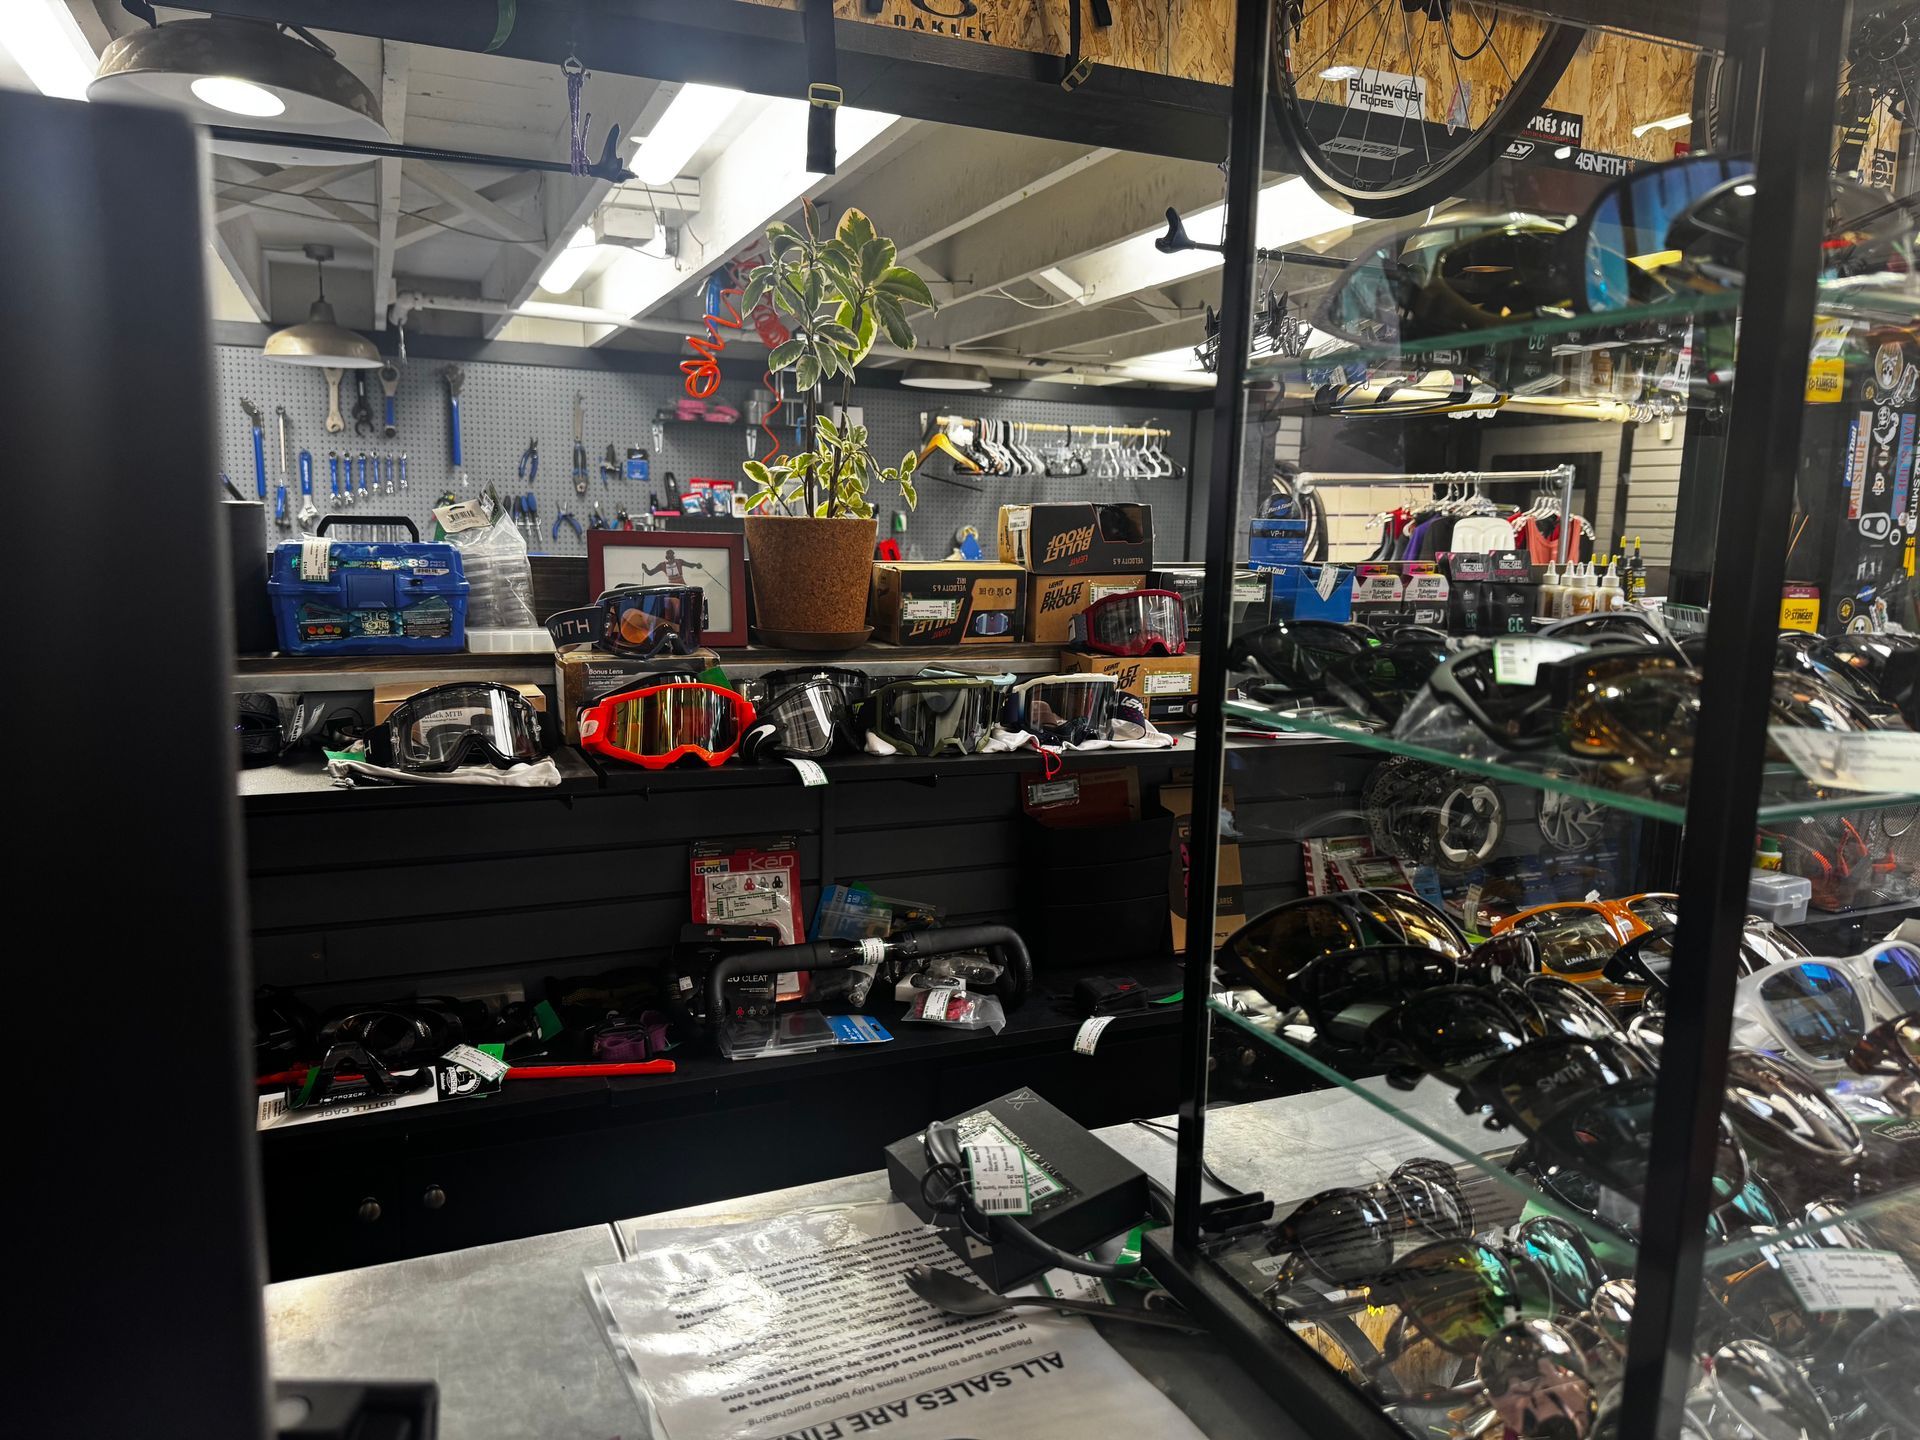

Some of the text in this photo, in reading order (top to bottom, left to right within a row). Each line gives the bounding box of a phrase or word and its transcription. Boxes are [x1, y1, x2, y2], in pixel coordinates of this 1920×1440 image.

[894, 14, 992, 41] OAKLEY
[1349, 78, 1423, 101] BlueWater
[1360, 94, 1394, 109] Ropes
[1527, 113, 1557, 133] PRÉS
[1560, 120, 1580, 139] SKI
[1575, 151, 1627, 177] 45NRTH
[1048, 524, 1096, 548] PROOF
[1043, 539, 1093, 564] BULLET
[942, 584, 967, 592] VELOCITY
[1043, 582, 1085, 601] BULLET
[1039, 592, 1083, 614] PROOF
[360, 610, 389, 622] BIG
[550, 618, 590, 639] MITH
[445, 710, 463, 718] MTB
[695, 865, 720, 874] LOOK
[1564, 957, 1585, 966] LUMA
[741, 974, 769, 983] CLEAT
[1536, 1061, 1587, 1092] SMITH
[317, 1100, 397, 1119] BOTTLE CAGE
[859, 1244, 891, 1255] small
[898, 1242, 936, 1253] selling
[869, 1251, 901, 1261] these
[915, 1249, 946, 1260] allow
[885, 1256, 917, 1267] these
[776, 1285, 800, 1295] and
[886, 1288, 912, 1298] and
[673, 1311, 695, 1320] We
[907, 1304, 930, 1315] can
[904, 1317, 927, 1327] the
[996, 1313, 1020, 1324] will
[915, 1323, 946, 1336] after
[957, 1319, 999, 1335] accept
[1000, 1325, 1017, 1333] an
[1014, 1322, 1028, 1330] If
[861, 1331, 917, 1351] purchase
[916, 1331, 961, 1347] returns
[974, 1330, 1003, 1342] item
[900, 1343, 918, 1351] on
[929, 1341, 965, 1355] found
[898, 1355, 917, 1365] be
[916, 1351, 930, 1359] to
[843, 1360, 901, 1381] defective
[742, 1336, 1035, 1428] Please be sure to inspect items fully before purchasing.
[778, 1372, 815, 1387] basis
[812, 1376, 844, 1390] after
[746, 1387, 761, 1396] to
[760, 1381, 779, 1392] up
[844, 1352, 1071, 1433] ALL SALES ARE
[719, 1391, 746, 1403] one
[748, 1384, 813, 1408] purchase,
[727, 1403, 749, 1413] we
